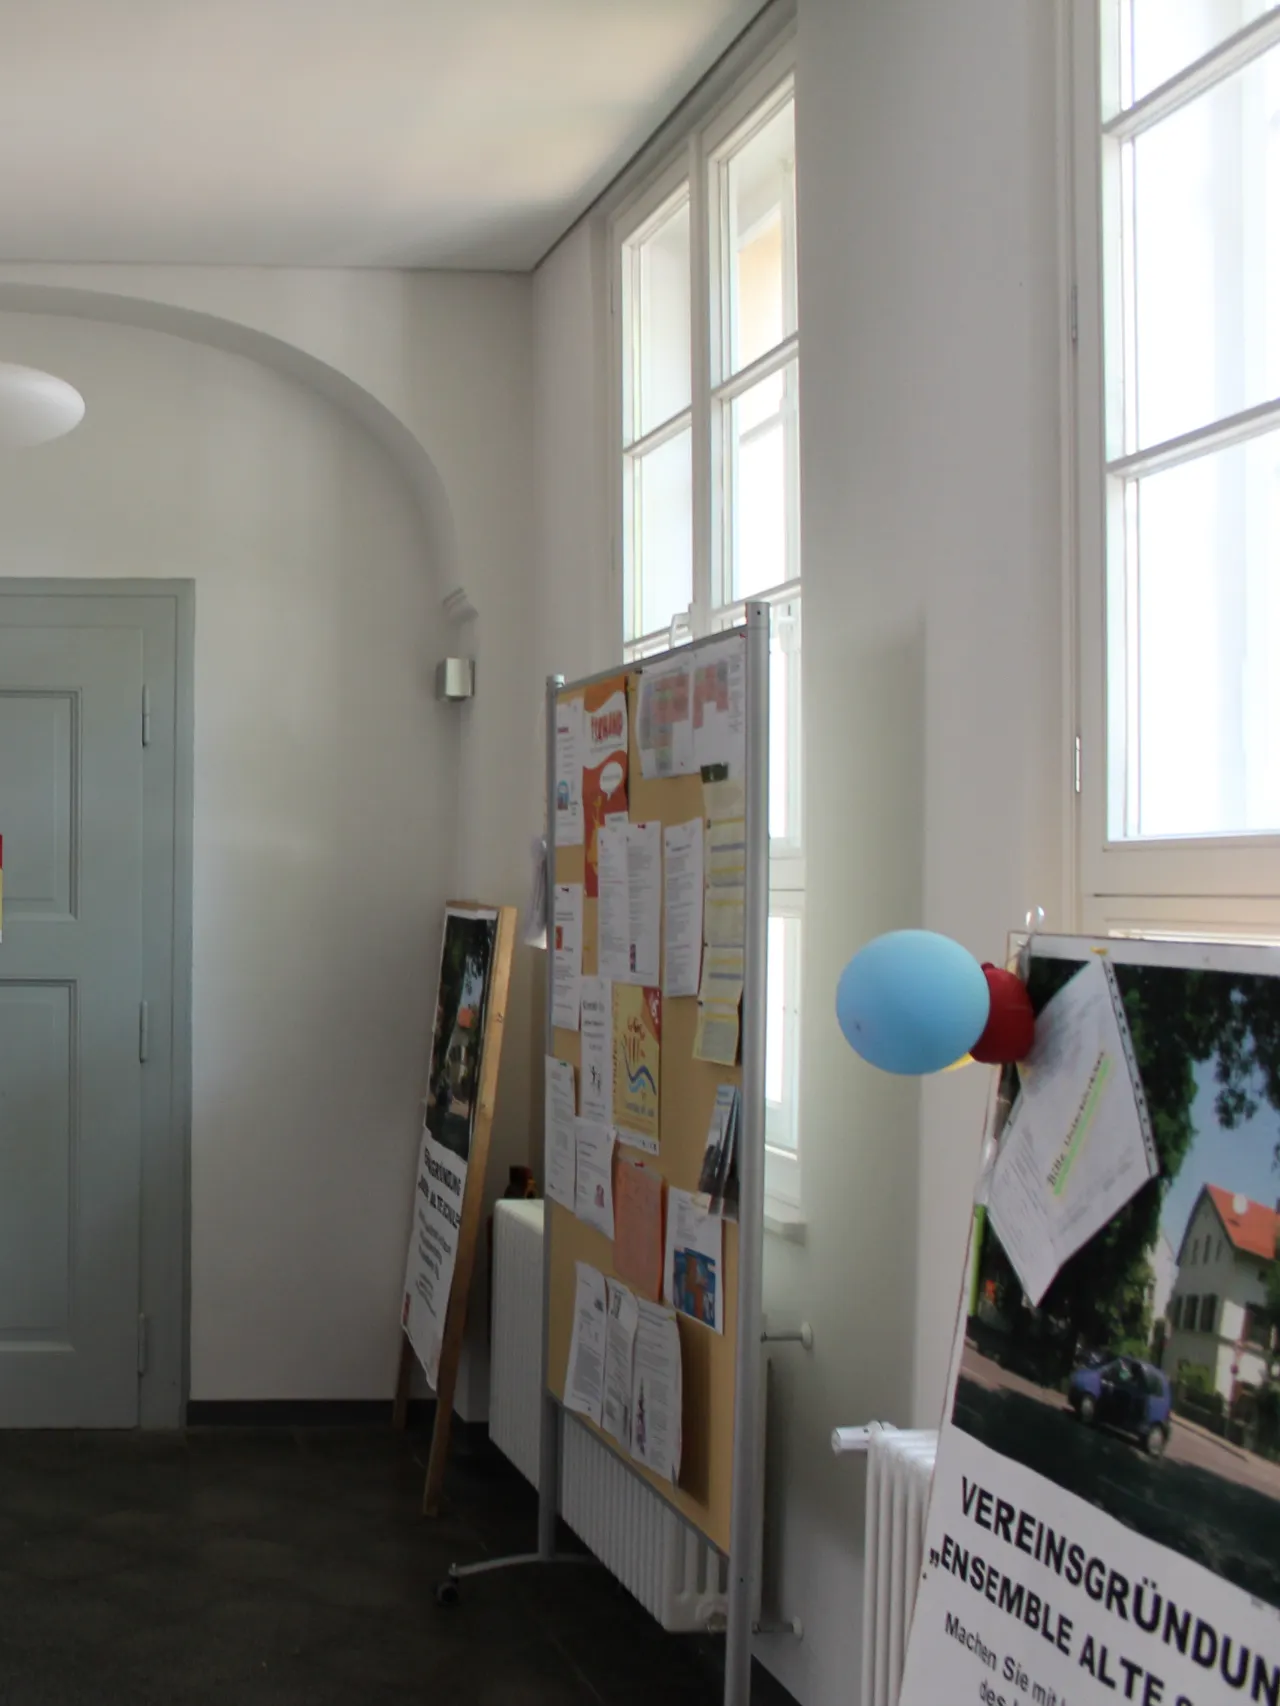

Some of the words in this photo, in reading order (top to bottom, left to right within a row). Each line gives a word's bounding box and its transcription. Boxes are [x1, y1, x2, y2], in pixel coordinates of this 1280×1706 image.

[944, 1611, 998, 1671] Machen
[1002, 1655, 1030, 1693] Sie
[1078, 1635, 1165, 1706] ALTE
[978, 1679, 1007, 1706] des
